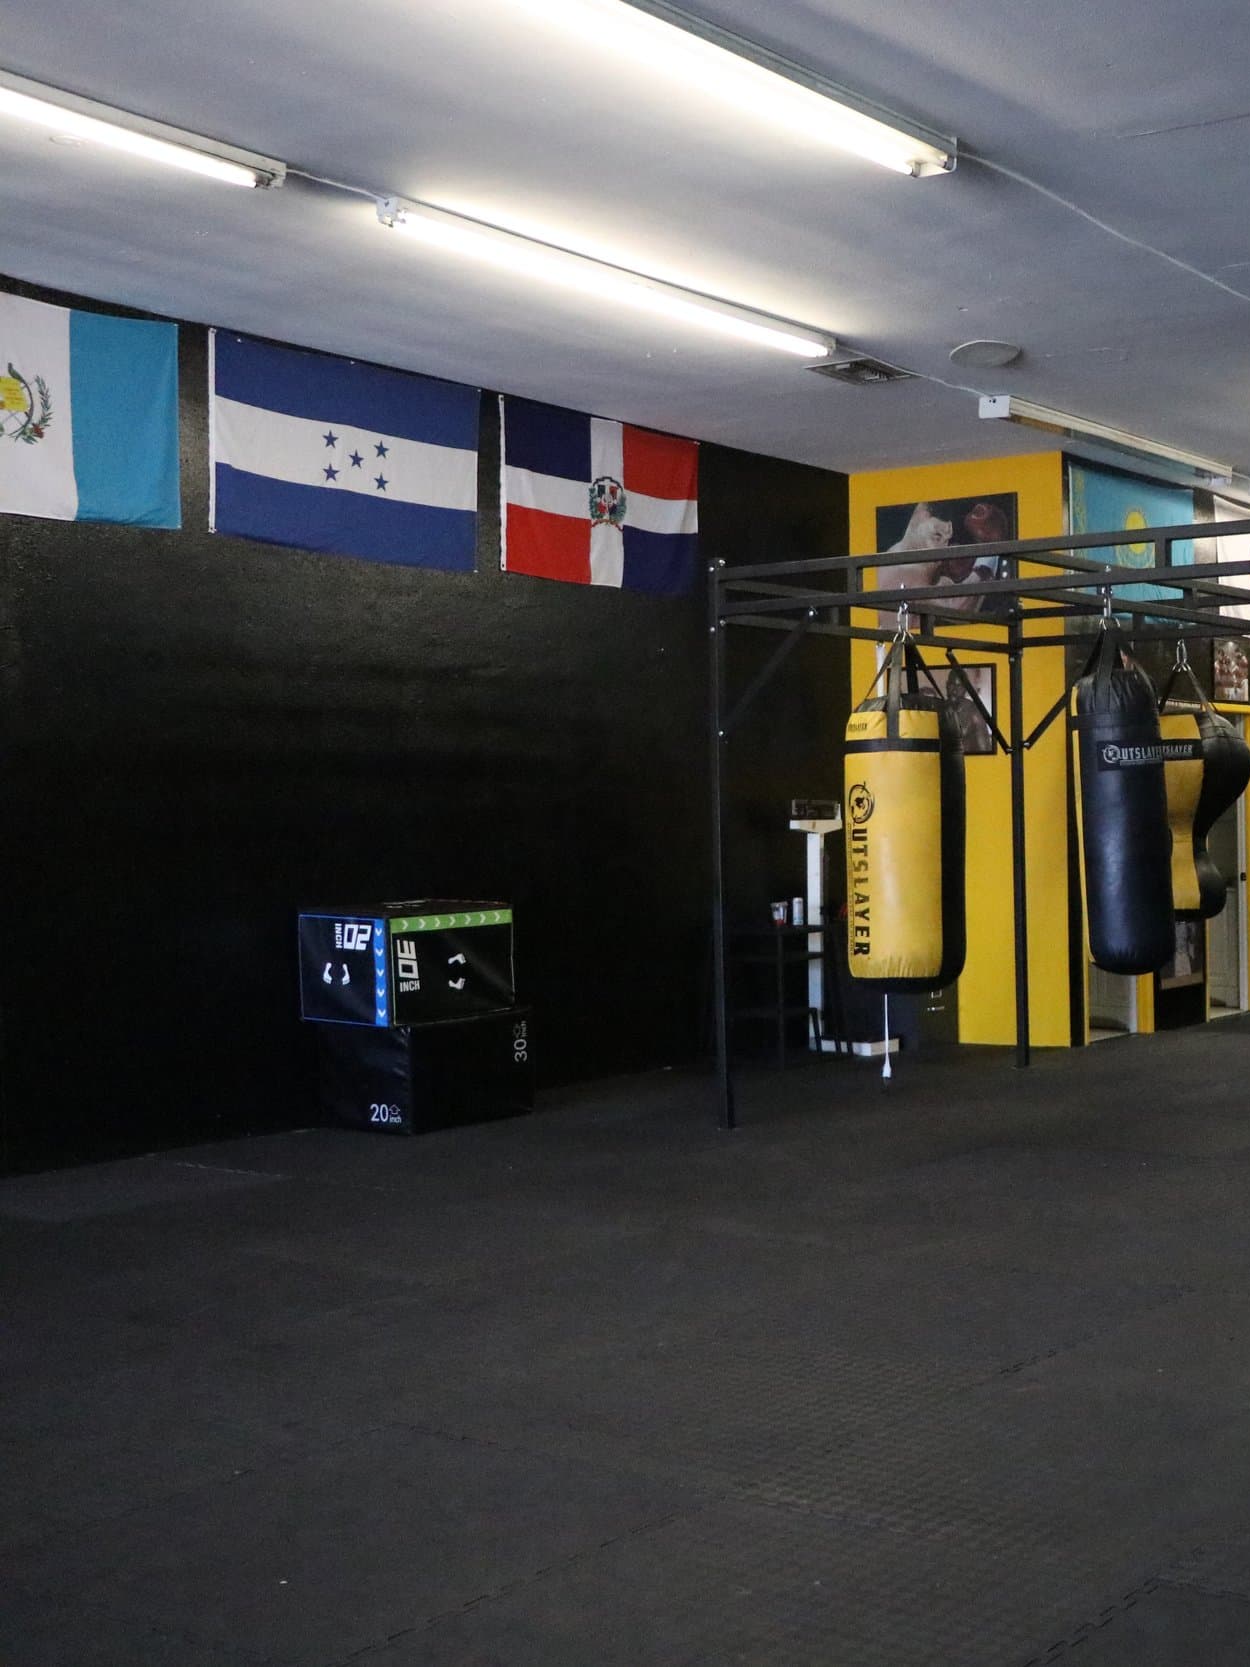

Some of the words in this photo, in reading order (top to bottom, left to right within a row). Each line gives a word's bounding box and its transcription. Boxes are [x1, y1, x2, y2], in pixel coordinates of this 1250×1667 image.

[335, 923, 343, 949] INCH
[400, 980, 420, 992] INCH
[514, 1039, 528, 1062] 30
[370, 1103, 389, 1122] 20
